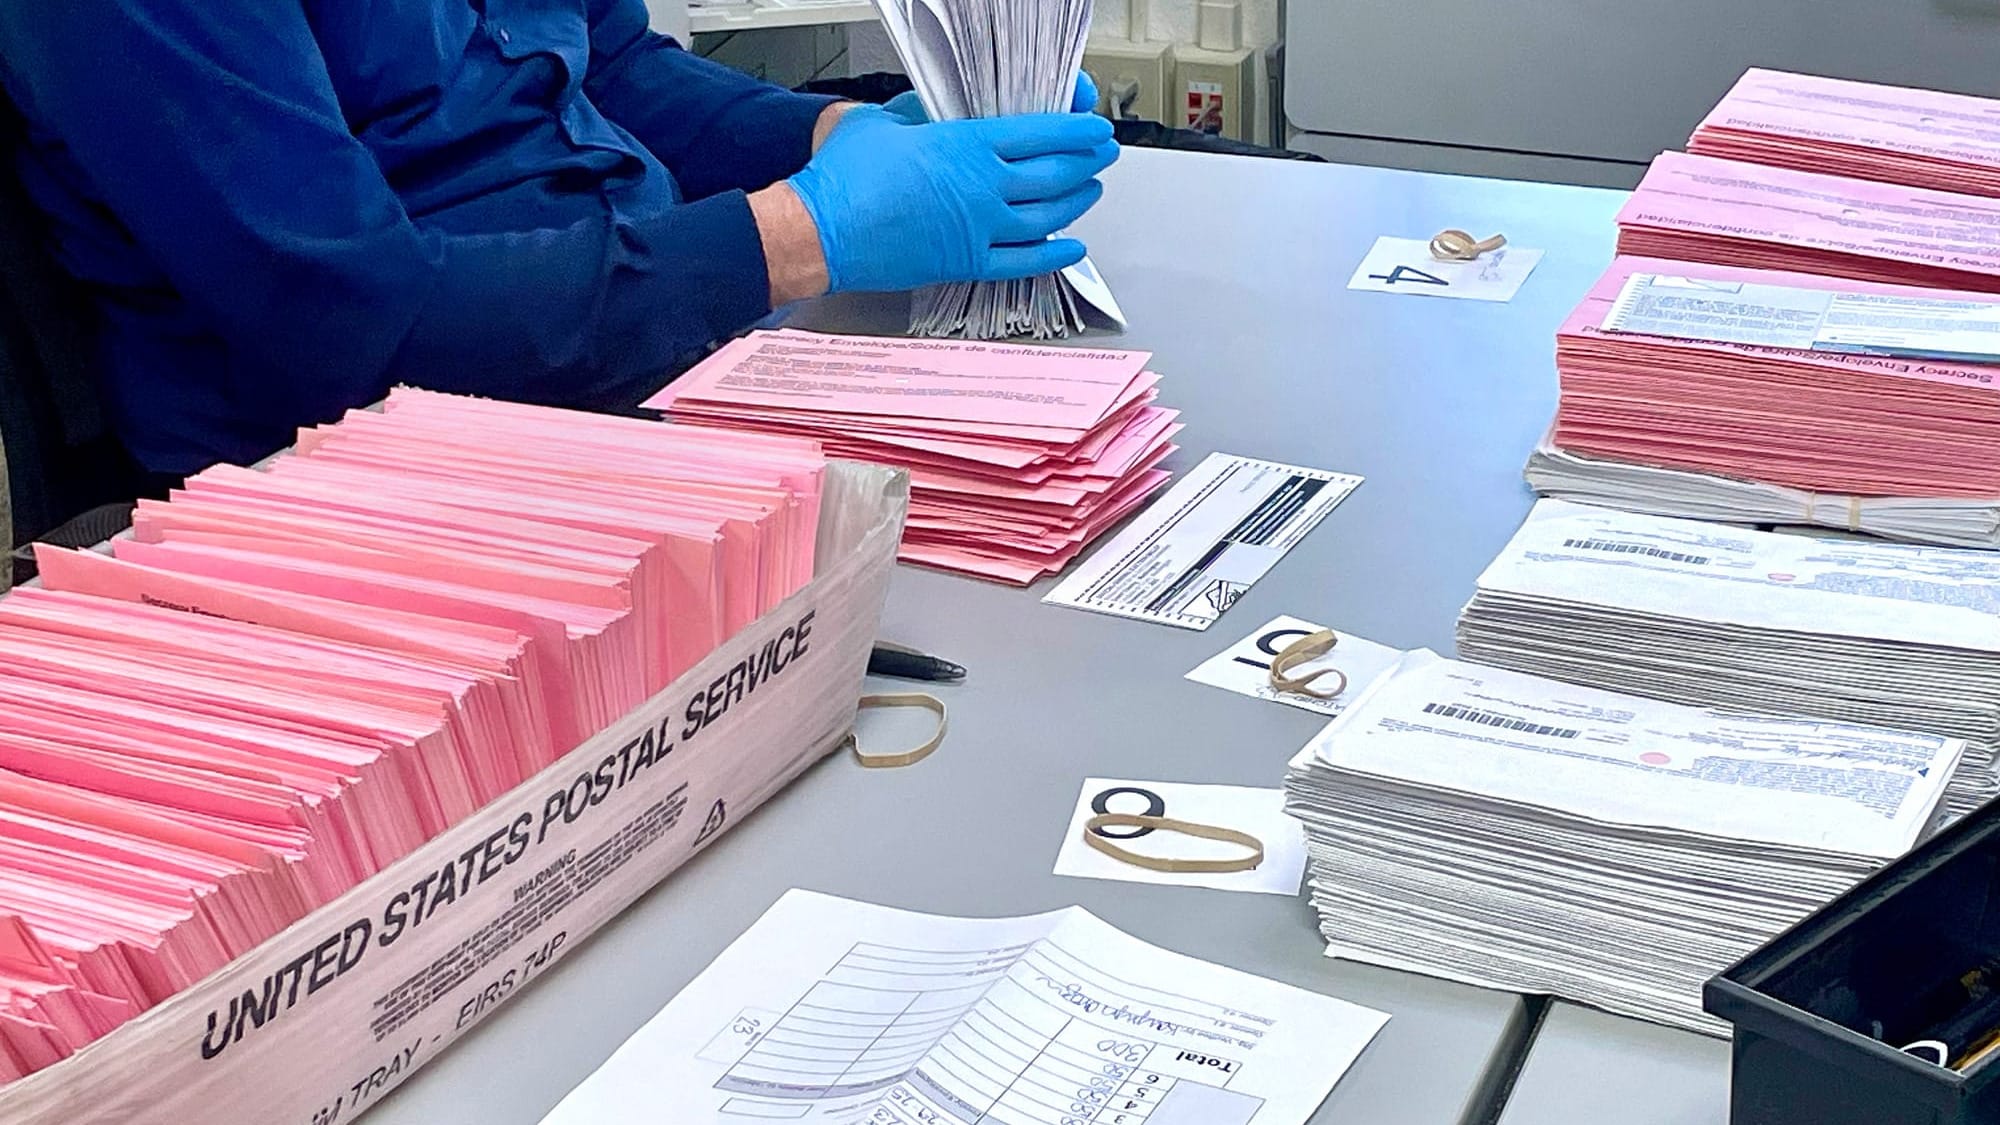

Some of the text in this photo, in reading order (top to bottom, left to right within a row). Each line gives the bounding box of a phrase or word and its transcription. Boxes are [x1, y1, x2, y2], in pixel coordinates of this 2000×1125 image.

[1369, 265, 1449, 286] 4
[1914, 365, 1994, 385] Secrecy
[201, 916, 372, 1061] UNITED
[378, 812, 531, 948] STATES
[538, 732, 674, 846] POSTAL
[681, 610, 817, 741] SERVICE
[513, 848, 577, 902] WARNING
[351, 1036, 421, 1109] TRAY
[456, 969, 517, 1030] EIRS
[523, 931, 568, 980] 74P
[1097, 1039, 1149, 1062] 300
[1175, 1051, 1233, 1073] Total
[1146, 1074, 1159, 1085] 6
[1135, 1087, 1150, 1098] 5
[1124, 1100, 1139, 1110] 4
[1113, 1114, 1127, 1125] 3
